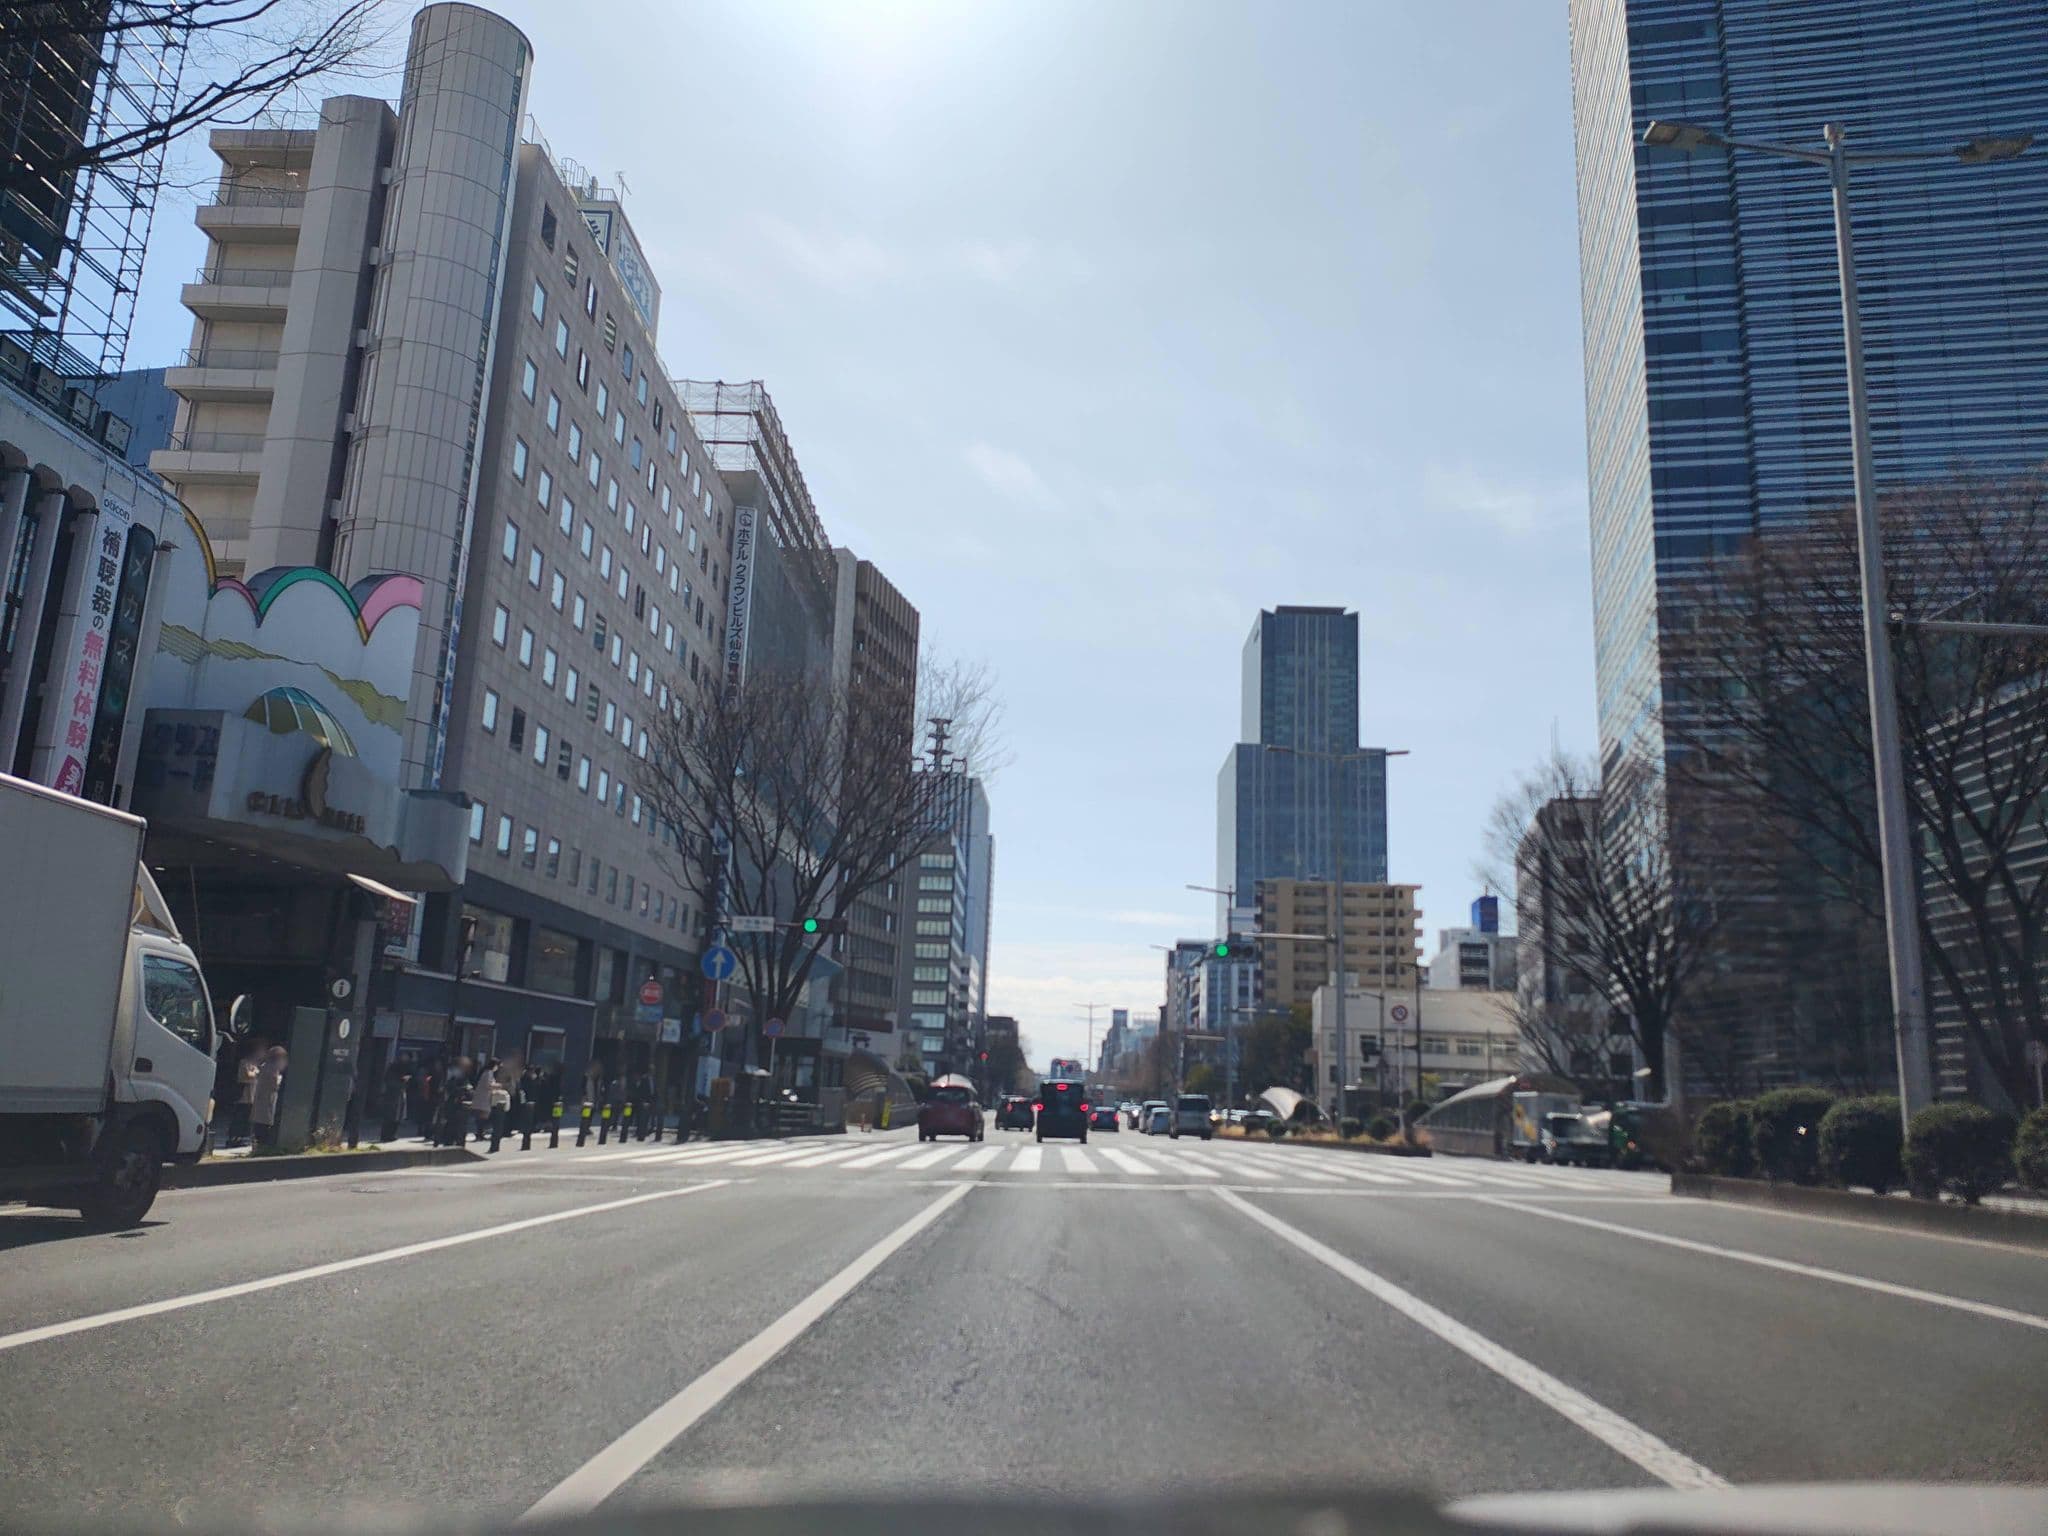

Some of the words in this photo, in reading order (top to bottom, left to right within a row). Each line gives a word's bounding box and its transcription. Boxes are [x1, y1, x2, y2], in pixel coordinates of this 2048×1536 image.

[103, 498, 130, 521] oticon
[727, 528, 751, 706] ホテルクラウンヒルズ仙台
